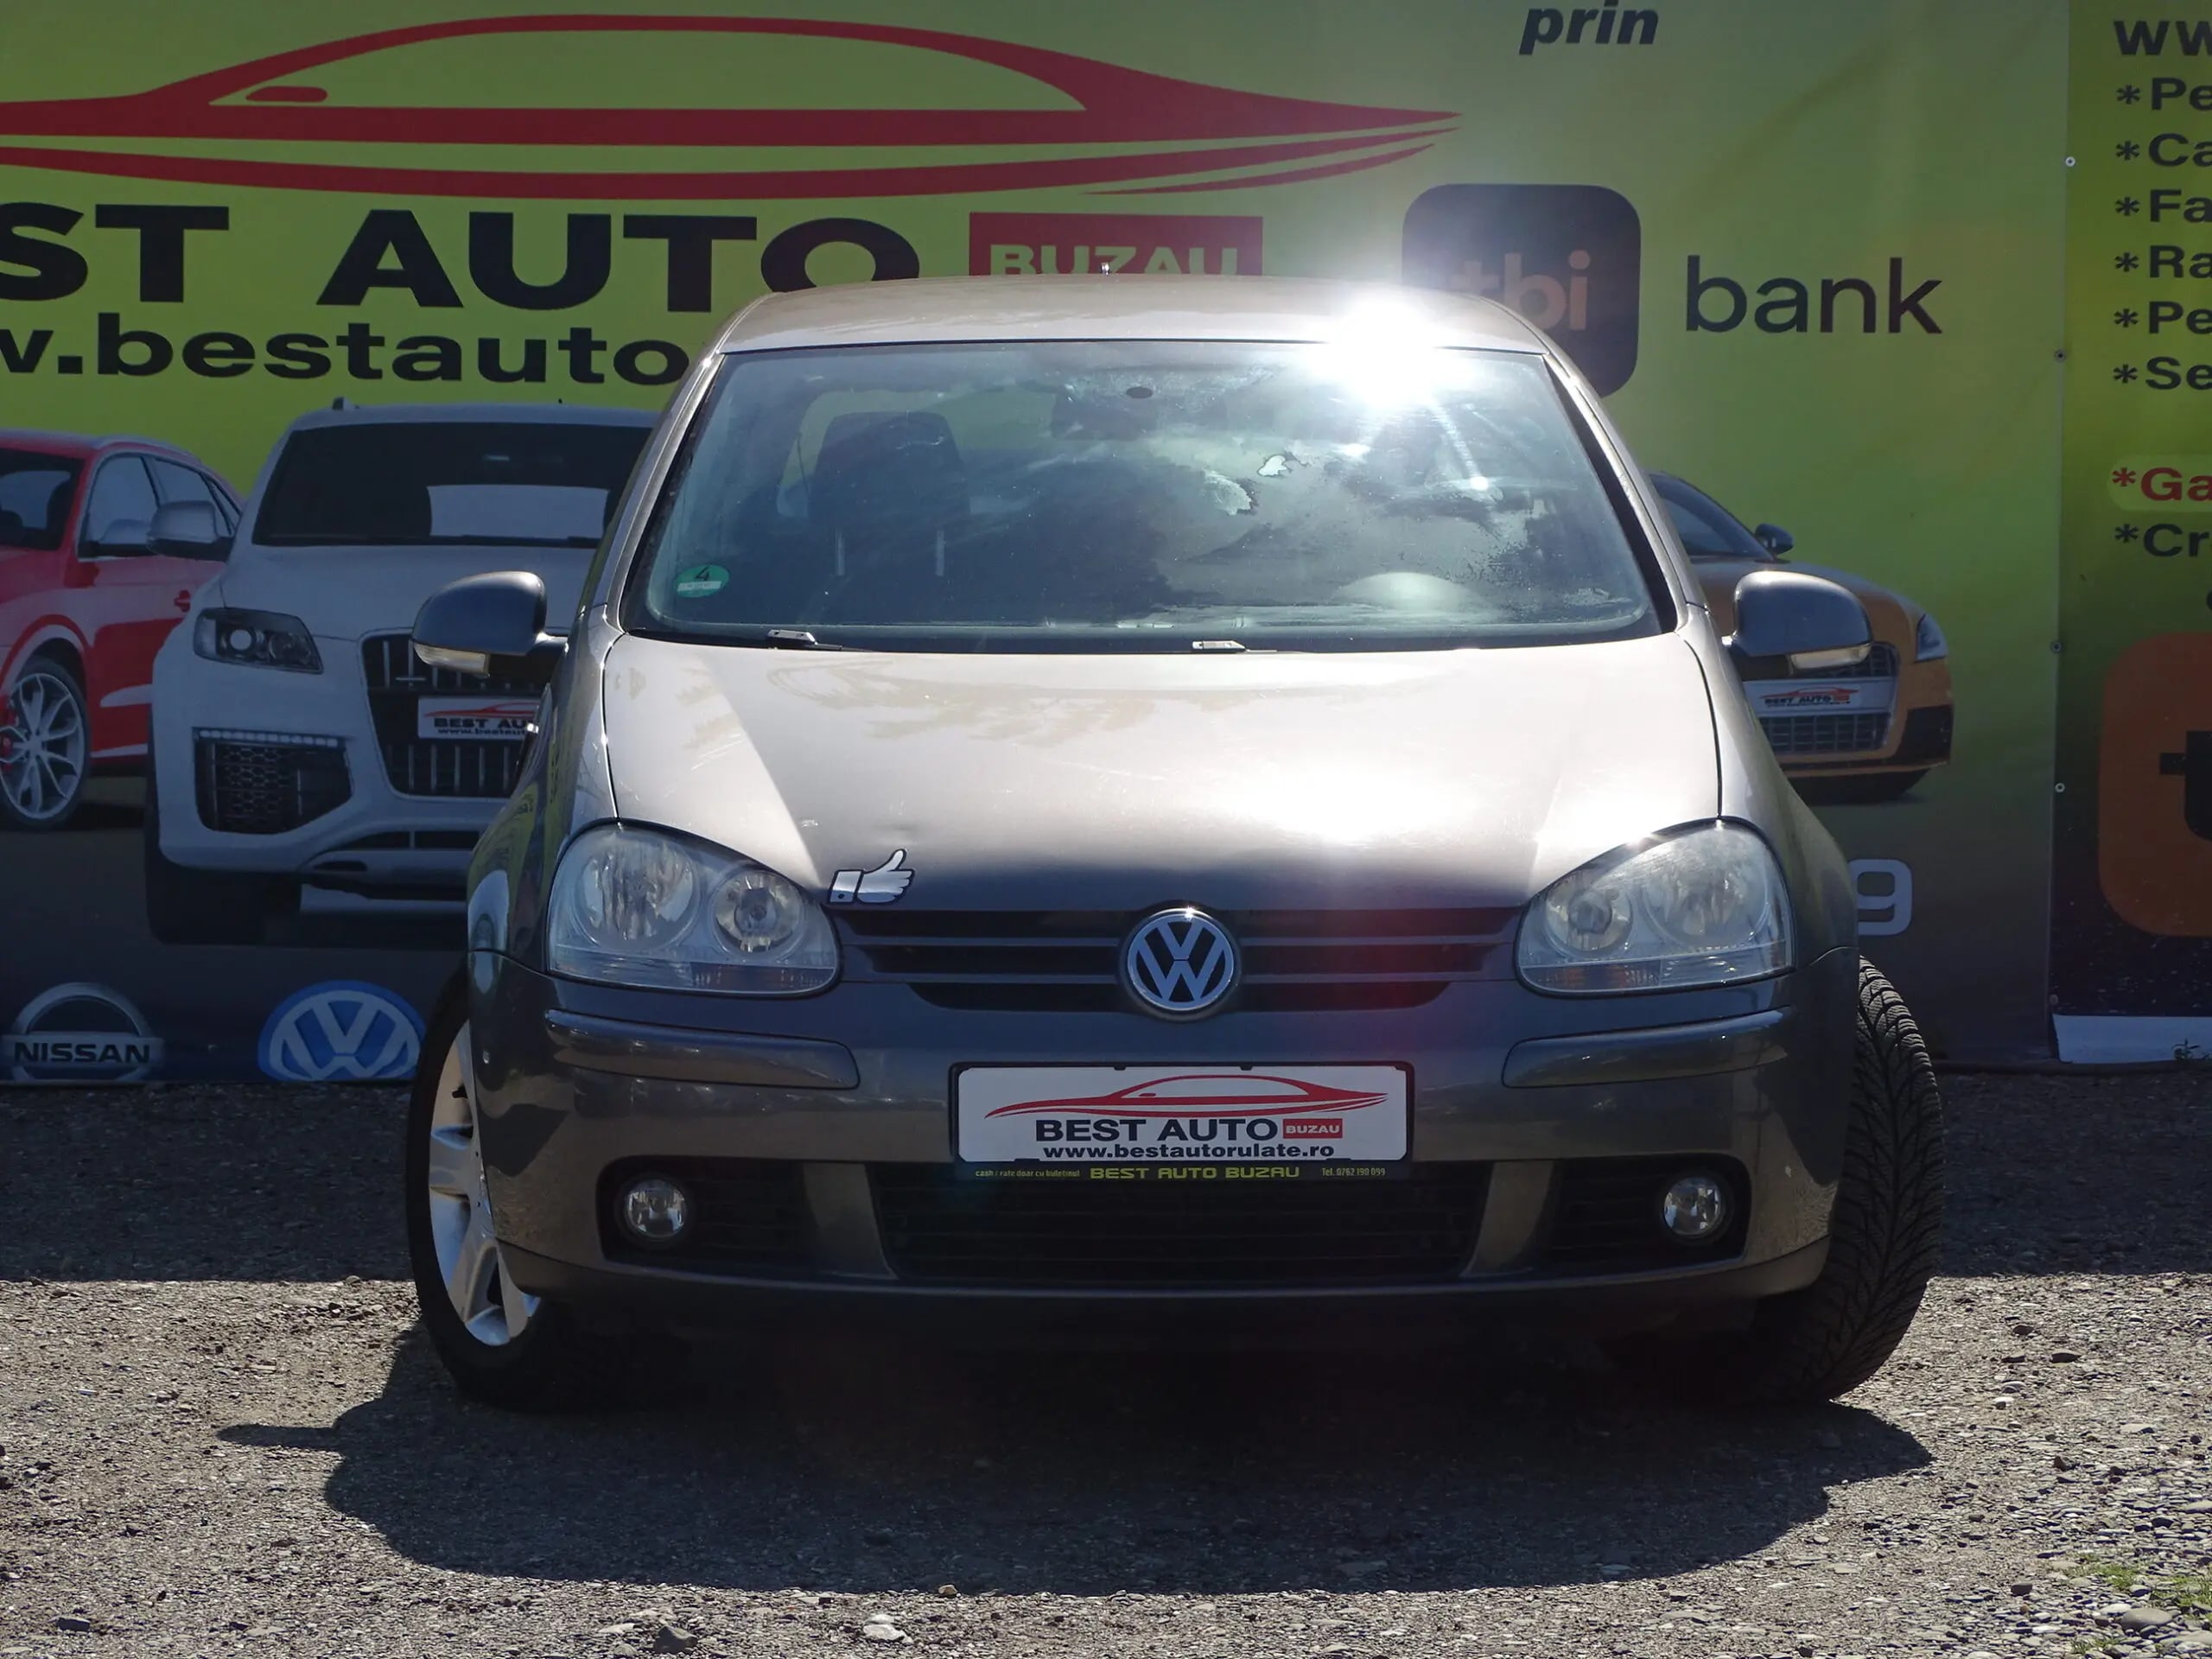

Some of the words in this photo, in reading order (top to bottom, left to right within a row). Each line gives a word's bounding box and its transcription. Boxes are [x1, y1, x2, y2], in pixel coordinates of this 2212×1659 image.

[1519, 0, 1658, 55] prin
[316, 209, 920, 313] AUTO
[1686, 255, 1942, 334] bank
[695, 566, 711, 581] 4
[434, 718, 489, 728] BEST
[1849, 859, 1913, 936] 9
[14, 1041, 149, 1064] NISSAN
[1036, 1119, 1147, 1141] BEST
[1157, 1118, 1278, 1141] AUTO
[1286, 1125, 1340, 1134] BUZAU
[1043, 1143, 1334, 1159] www.bestautorulate.ro
[1090, 1167, 1150, 1179] BEST
[1158, 1167, 1217, 1179] AUTO
[1225, 1167, 1300, 1179] BUZAU
